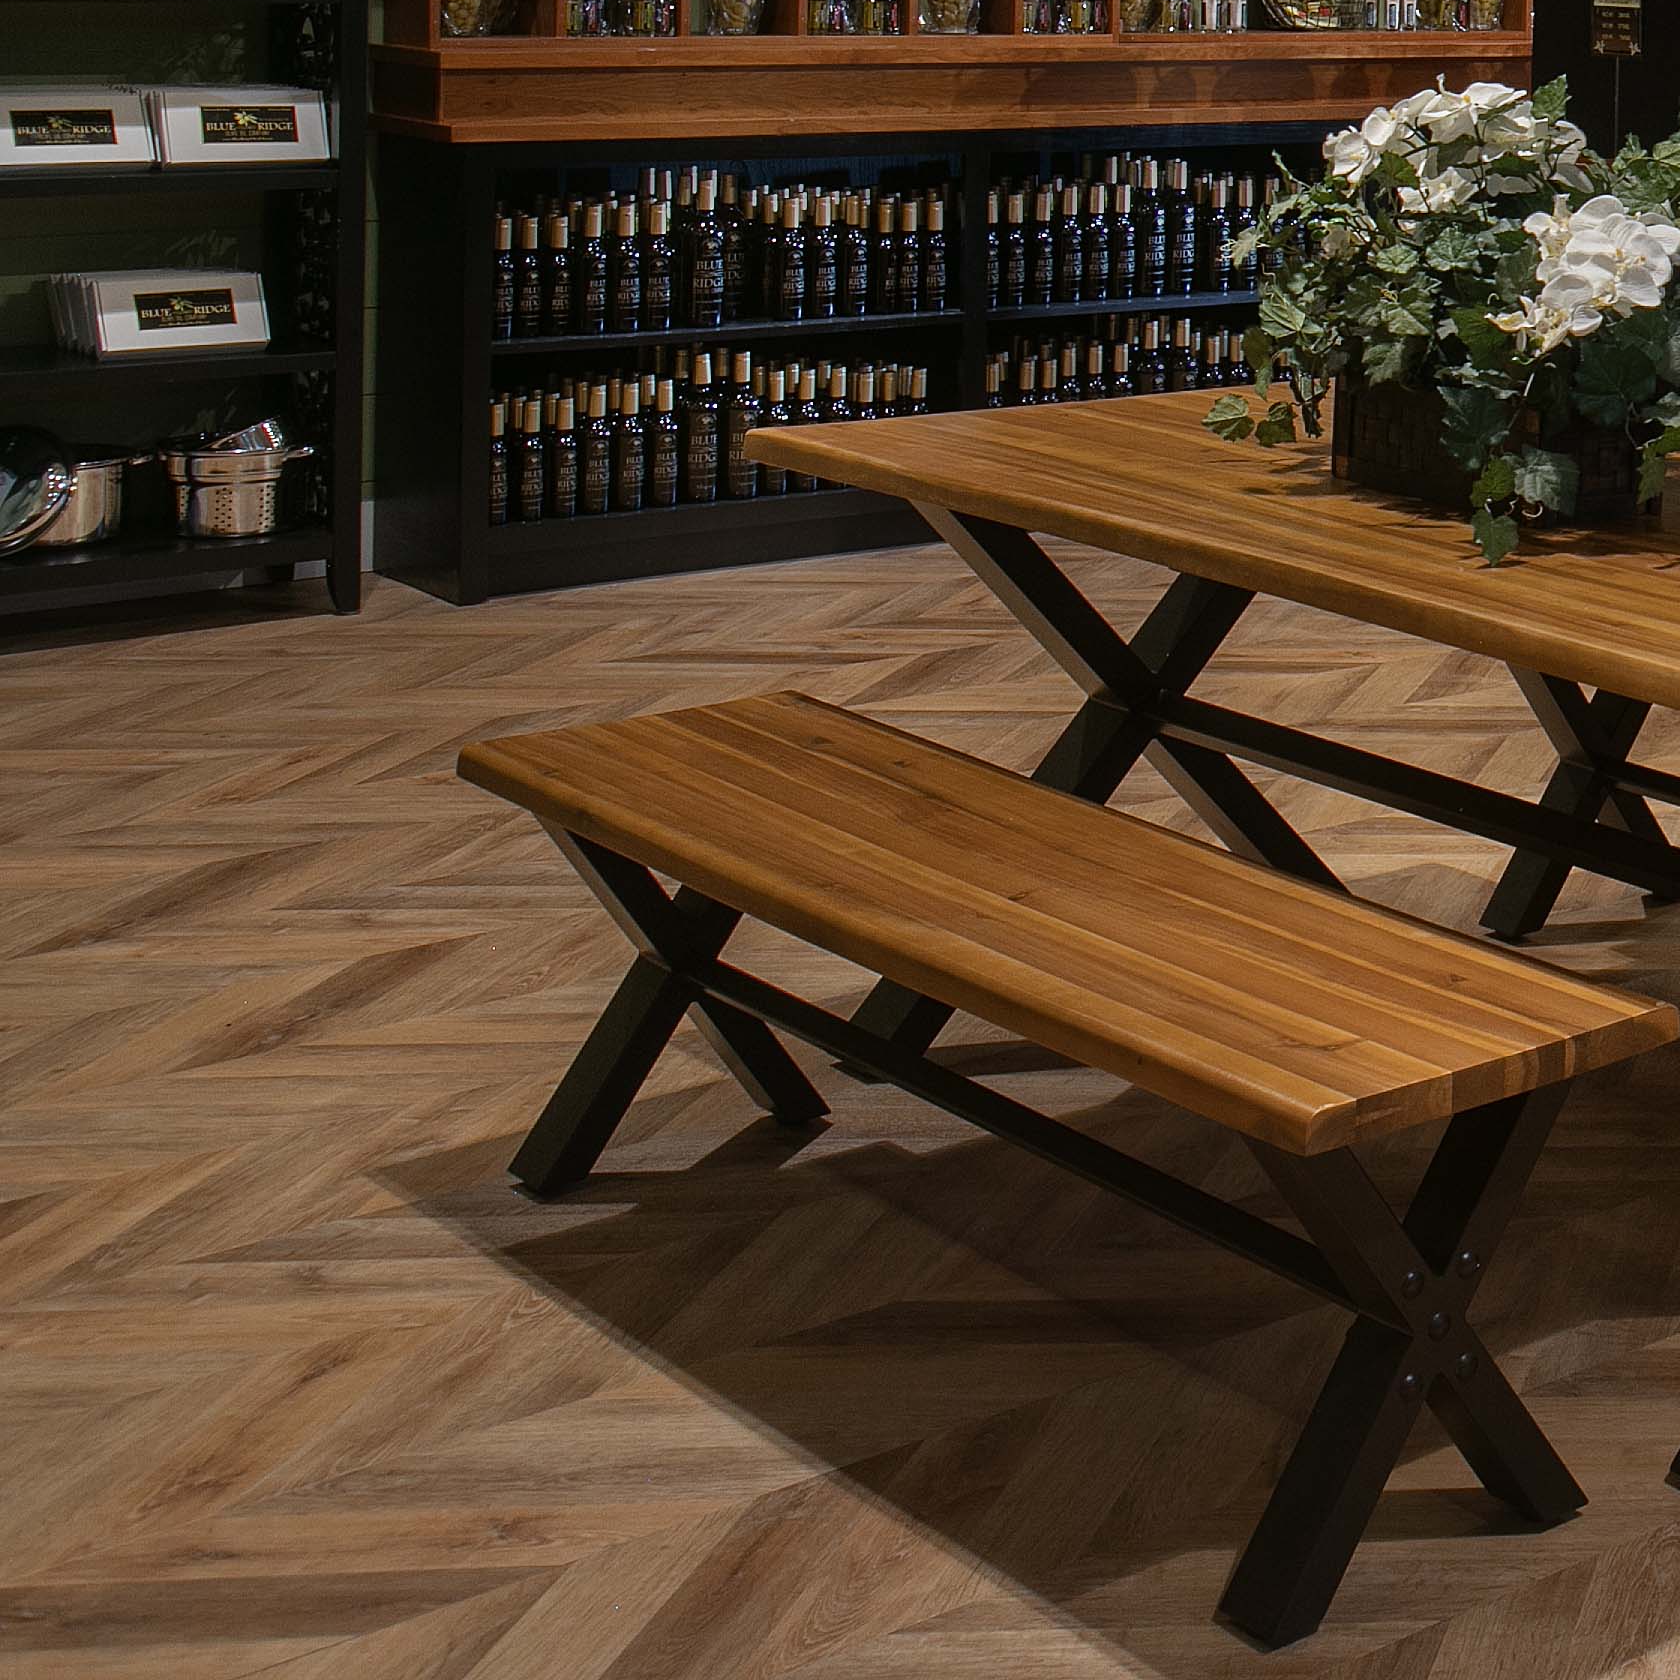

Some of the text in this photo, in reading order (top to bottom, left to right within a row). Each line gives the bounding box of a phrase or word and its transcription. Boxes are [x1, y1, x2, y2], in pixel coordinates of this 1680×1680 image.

[17, 125, 112, 137] BLUE RIDGE
[206, 122, 293, 132] BLUE RIDGE
[696, 260, 723, 270] BLUE
[140, 309, 172, 319] BLUE
[194, 304, 231, 314] RIDGE
